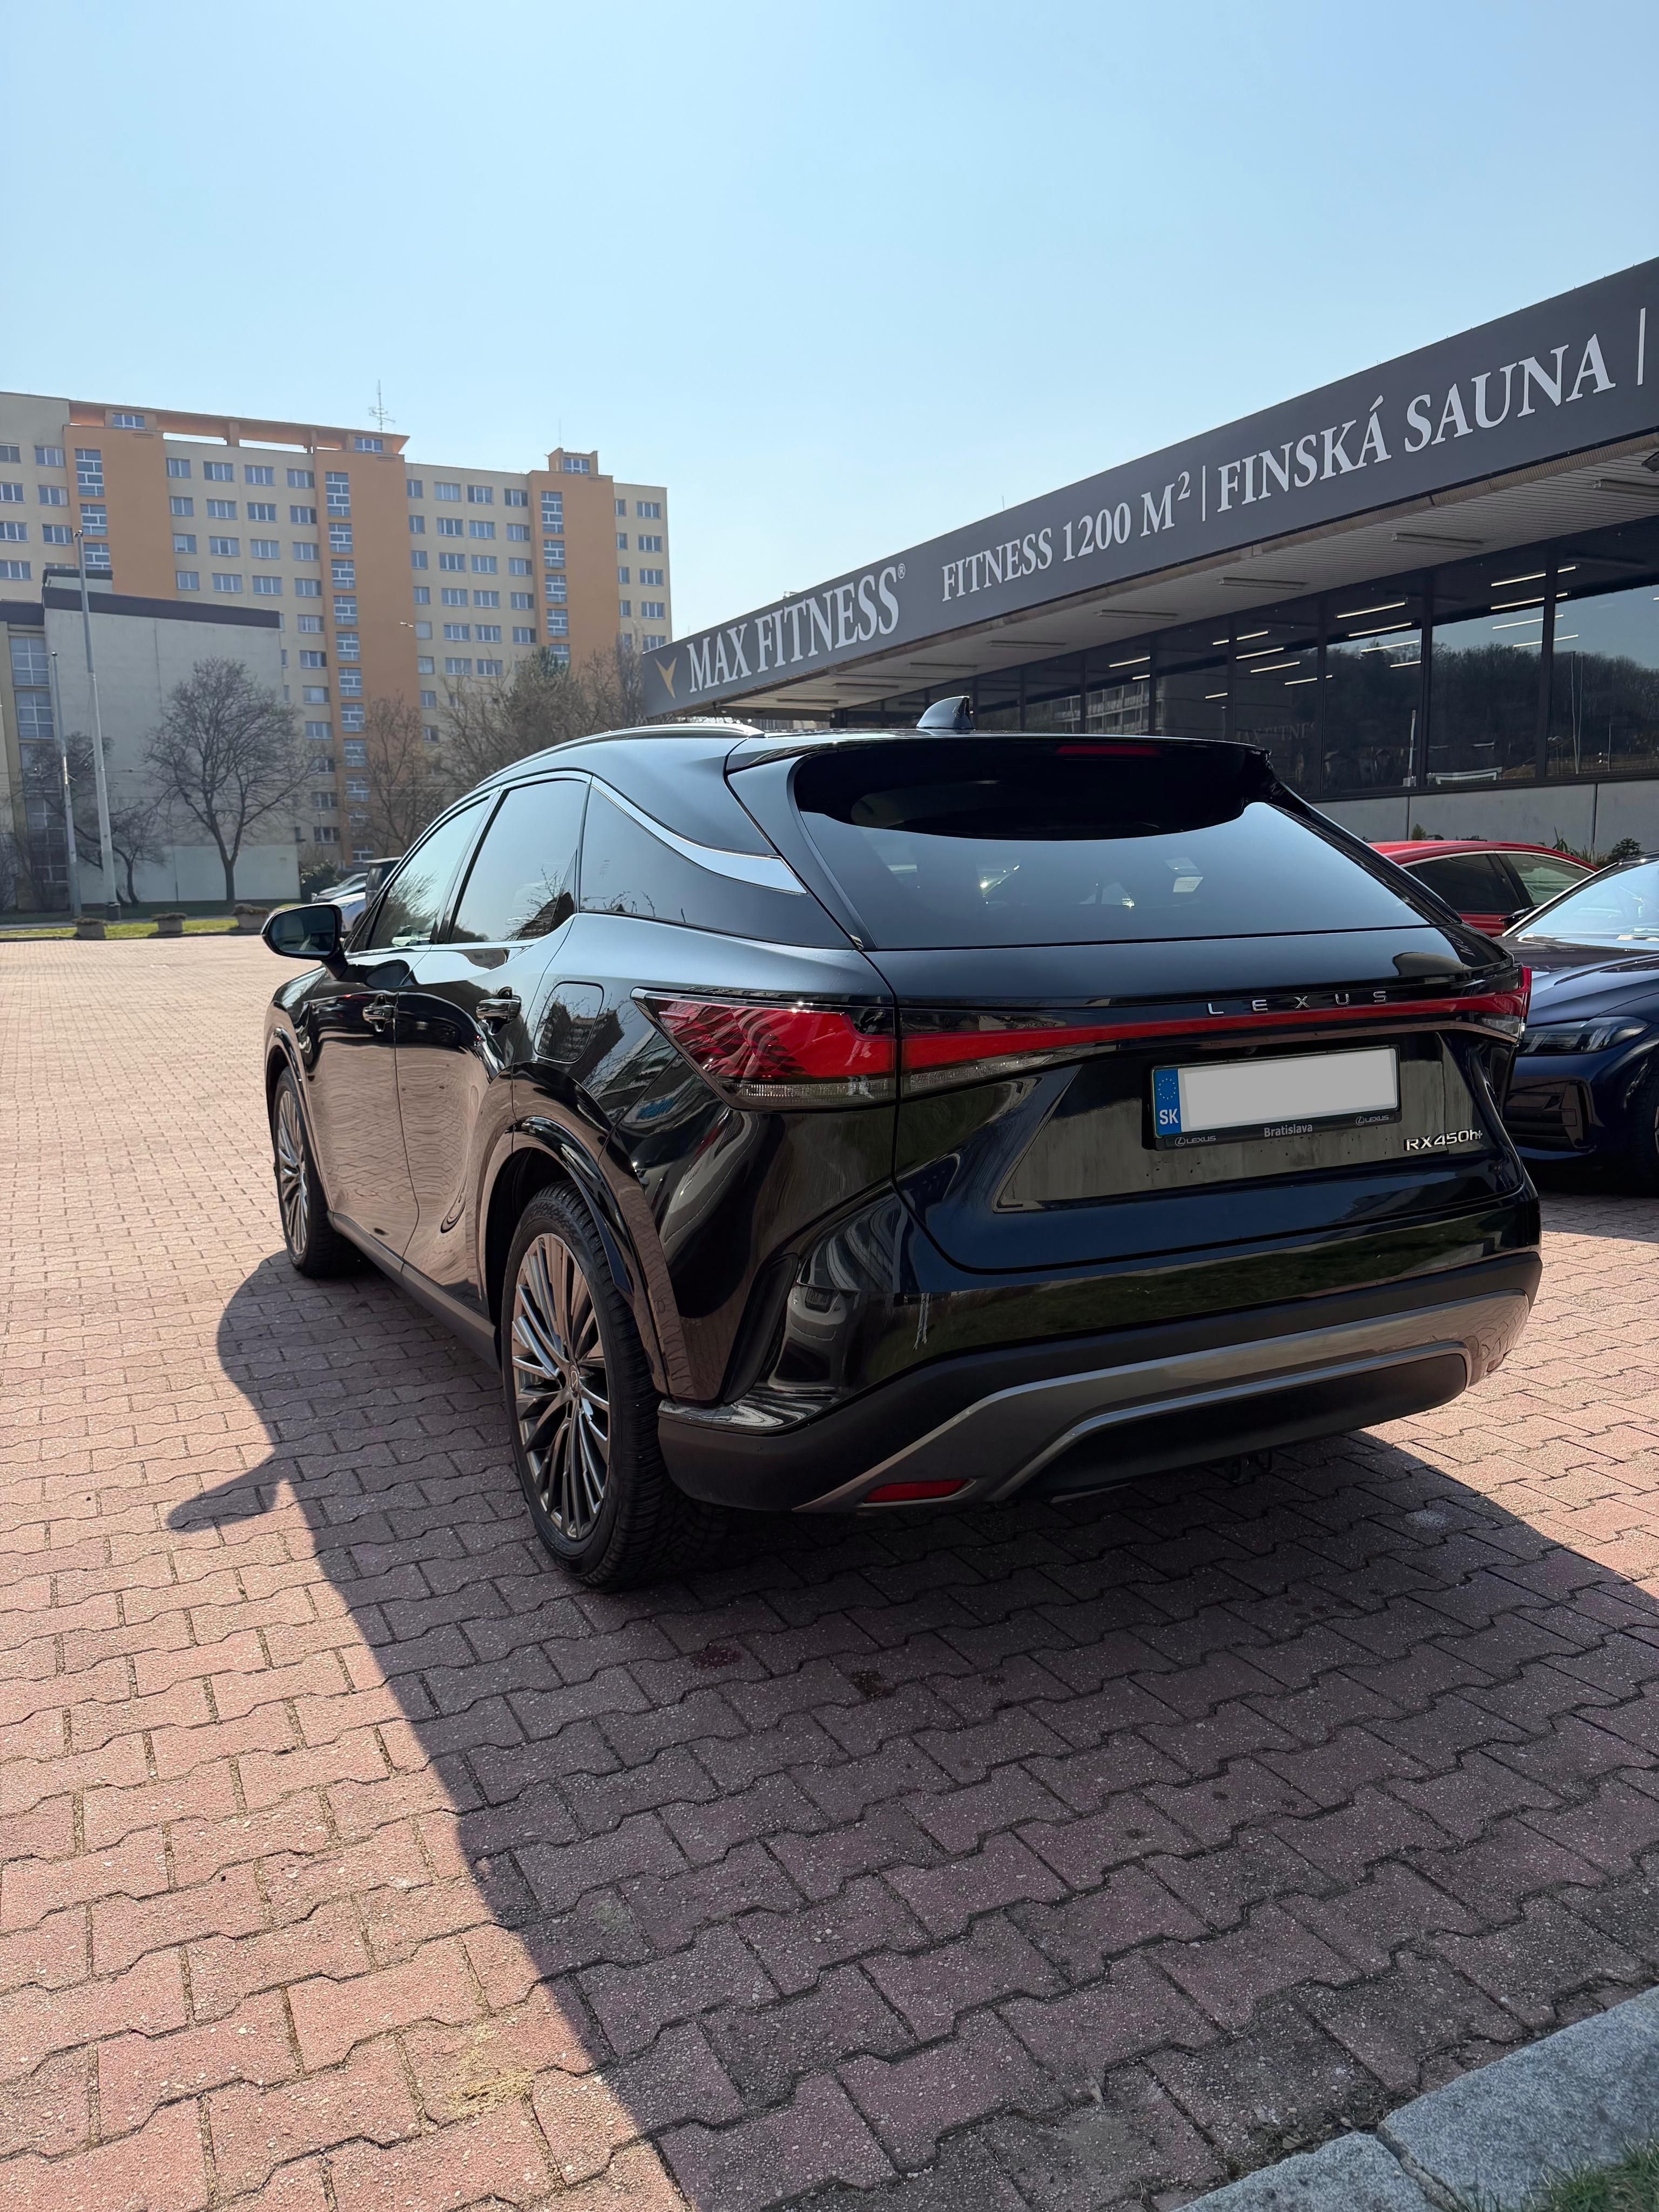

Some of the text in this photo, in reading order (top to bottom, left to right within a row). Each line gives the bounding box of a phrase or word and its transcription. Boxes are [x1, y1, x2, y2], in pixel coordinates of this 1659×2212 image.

[941, 527, 1053, 602] FITNESS
[1062, 502, 1131, 562] 1200
[1217, 395, 1392, 513] FINSKÁ
[1404, 333, 1616, 453] SAUNA
[686, 622, 752, 693] MAX
[1206, 990, 1388, 1015] LEXUS
[1159, 1108, 1179, 1125] SK
[1364, 1114, 1390, 1123] LEXUS
[1263, 1123, 1313, 1138] Bratislava
[1185, 1135, 1216, 1144] LEXUS
